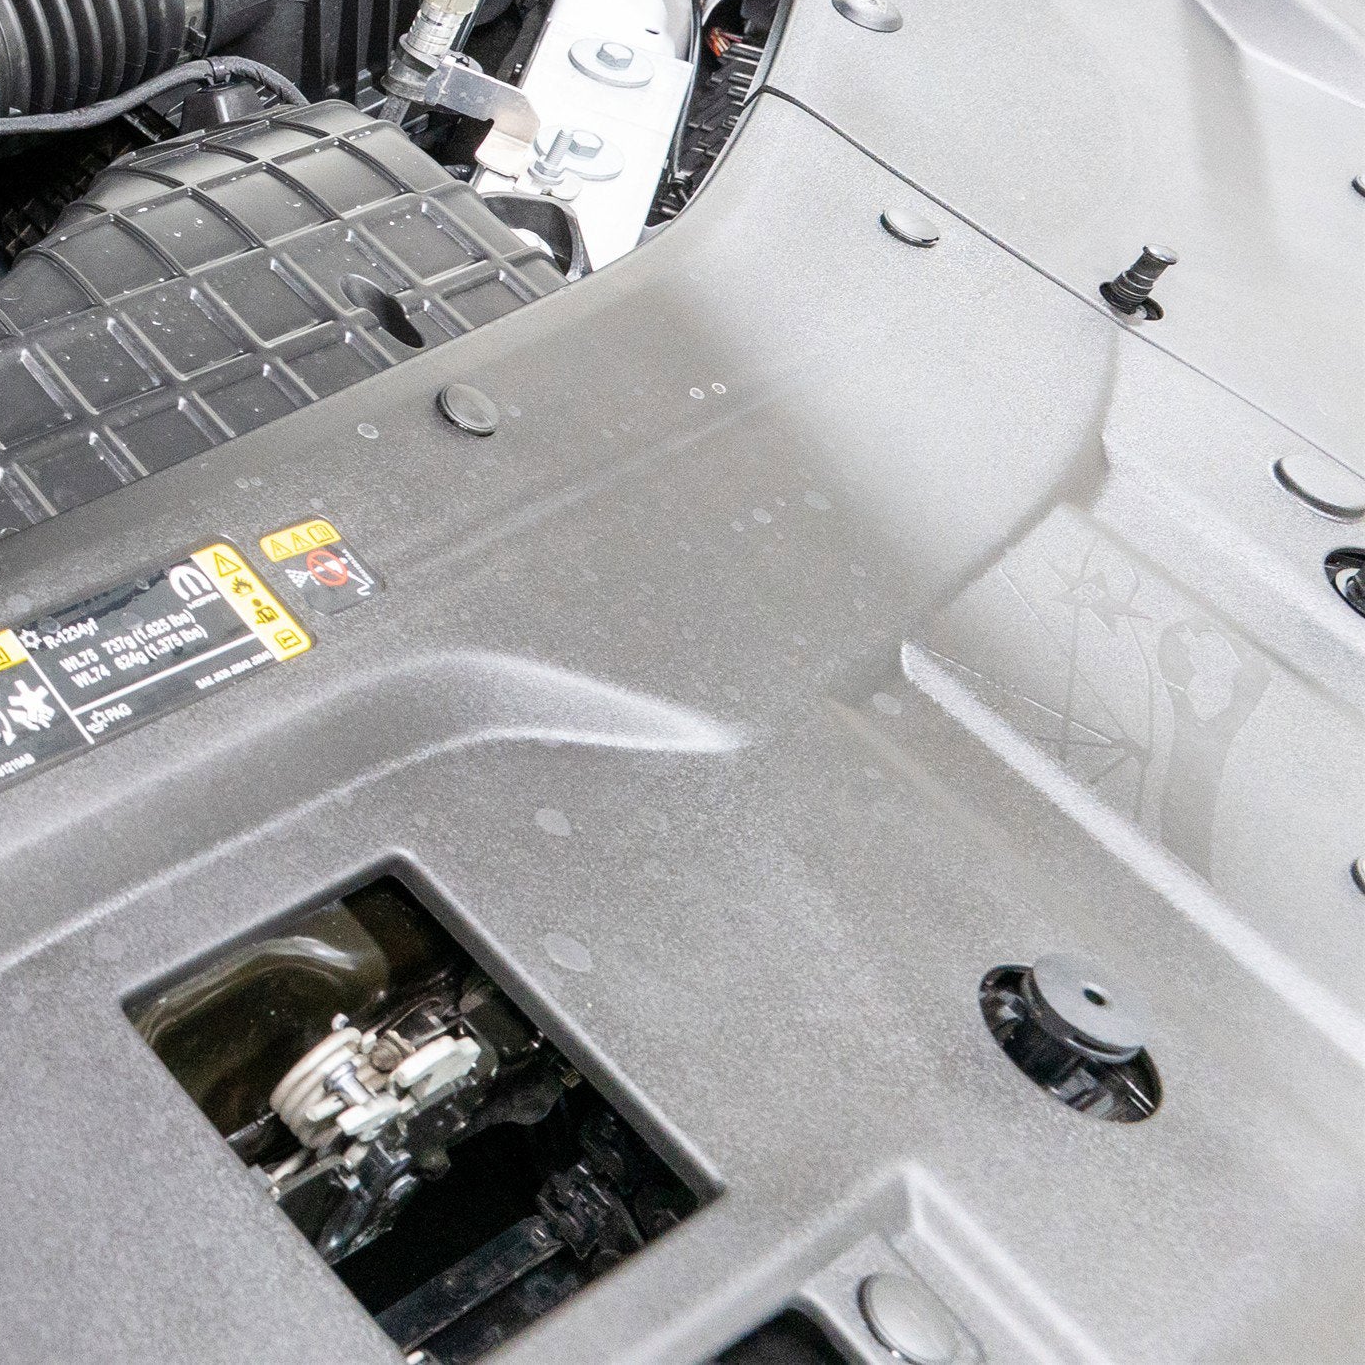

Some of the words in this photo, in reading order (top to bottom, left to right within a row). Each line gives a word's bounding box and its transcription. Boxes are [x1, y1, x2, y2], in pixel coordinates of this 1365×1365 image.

[42, 617, 100, 649] R-1234yf
[59, 648, 100, 672] WL75
[101, 635, 138, 655] 737g
[132, 618, 170, 645] (1.625
[71, 664, 111, 688] WL74
[114, 651, 150, 670] 624g
[144, 633, 184, 660] (1.375
[105, 702, 133, 722] PAG
